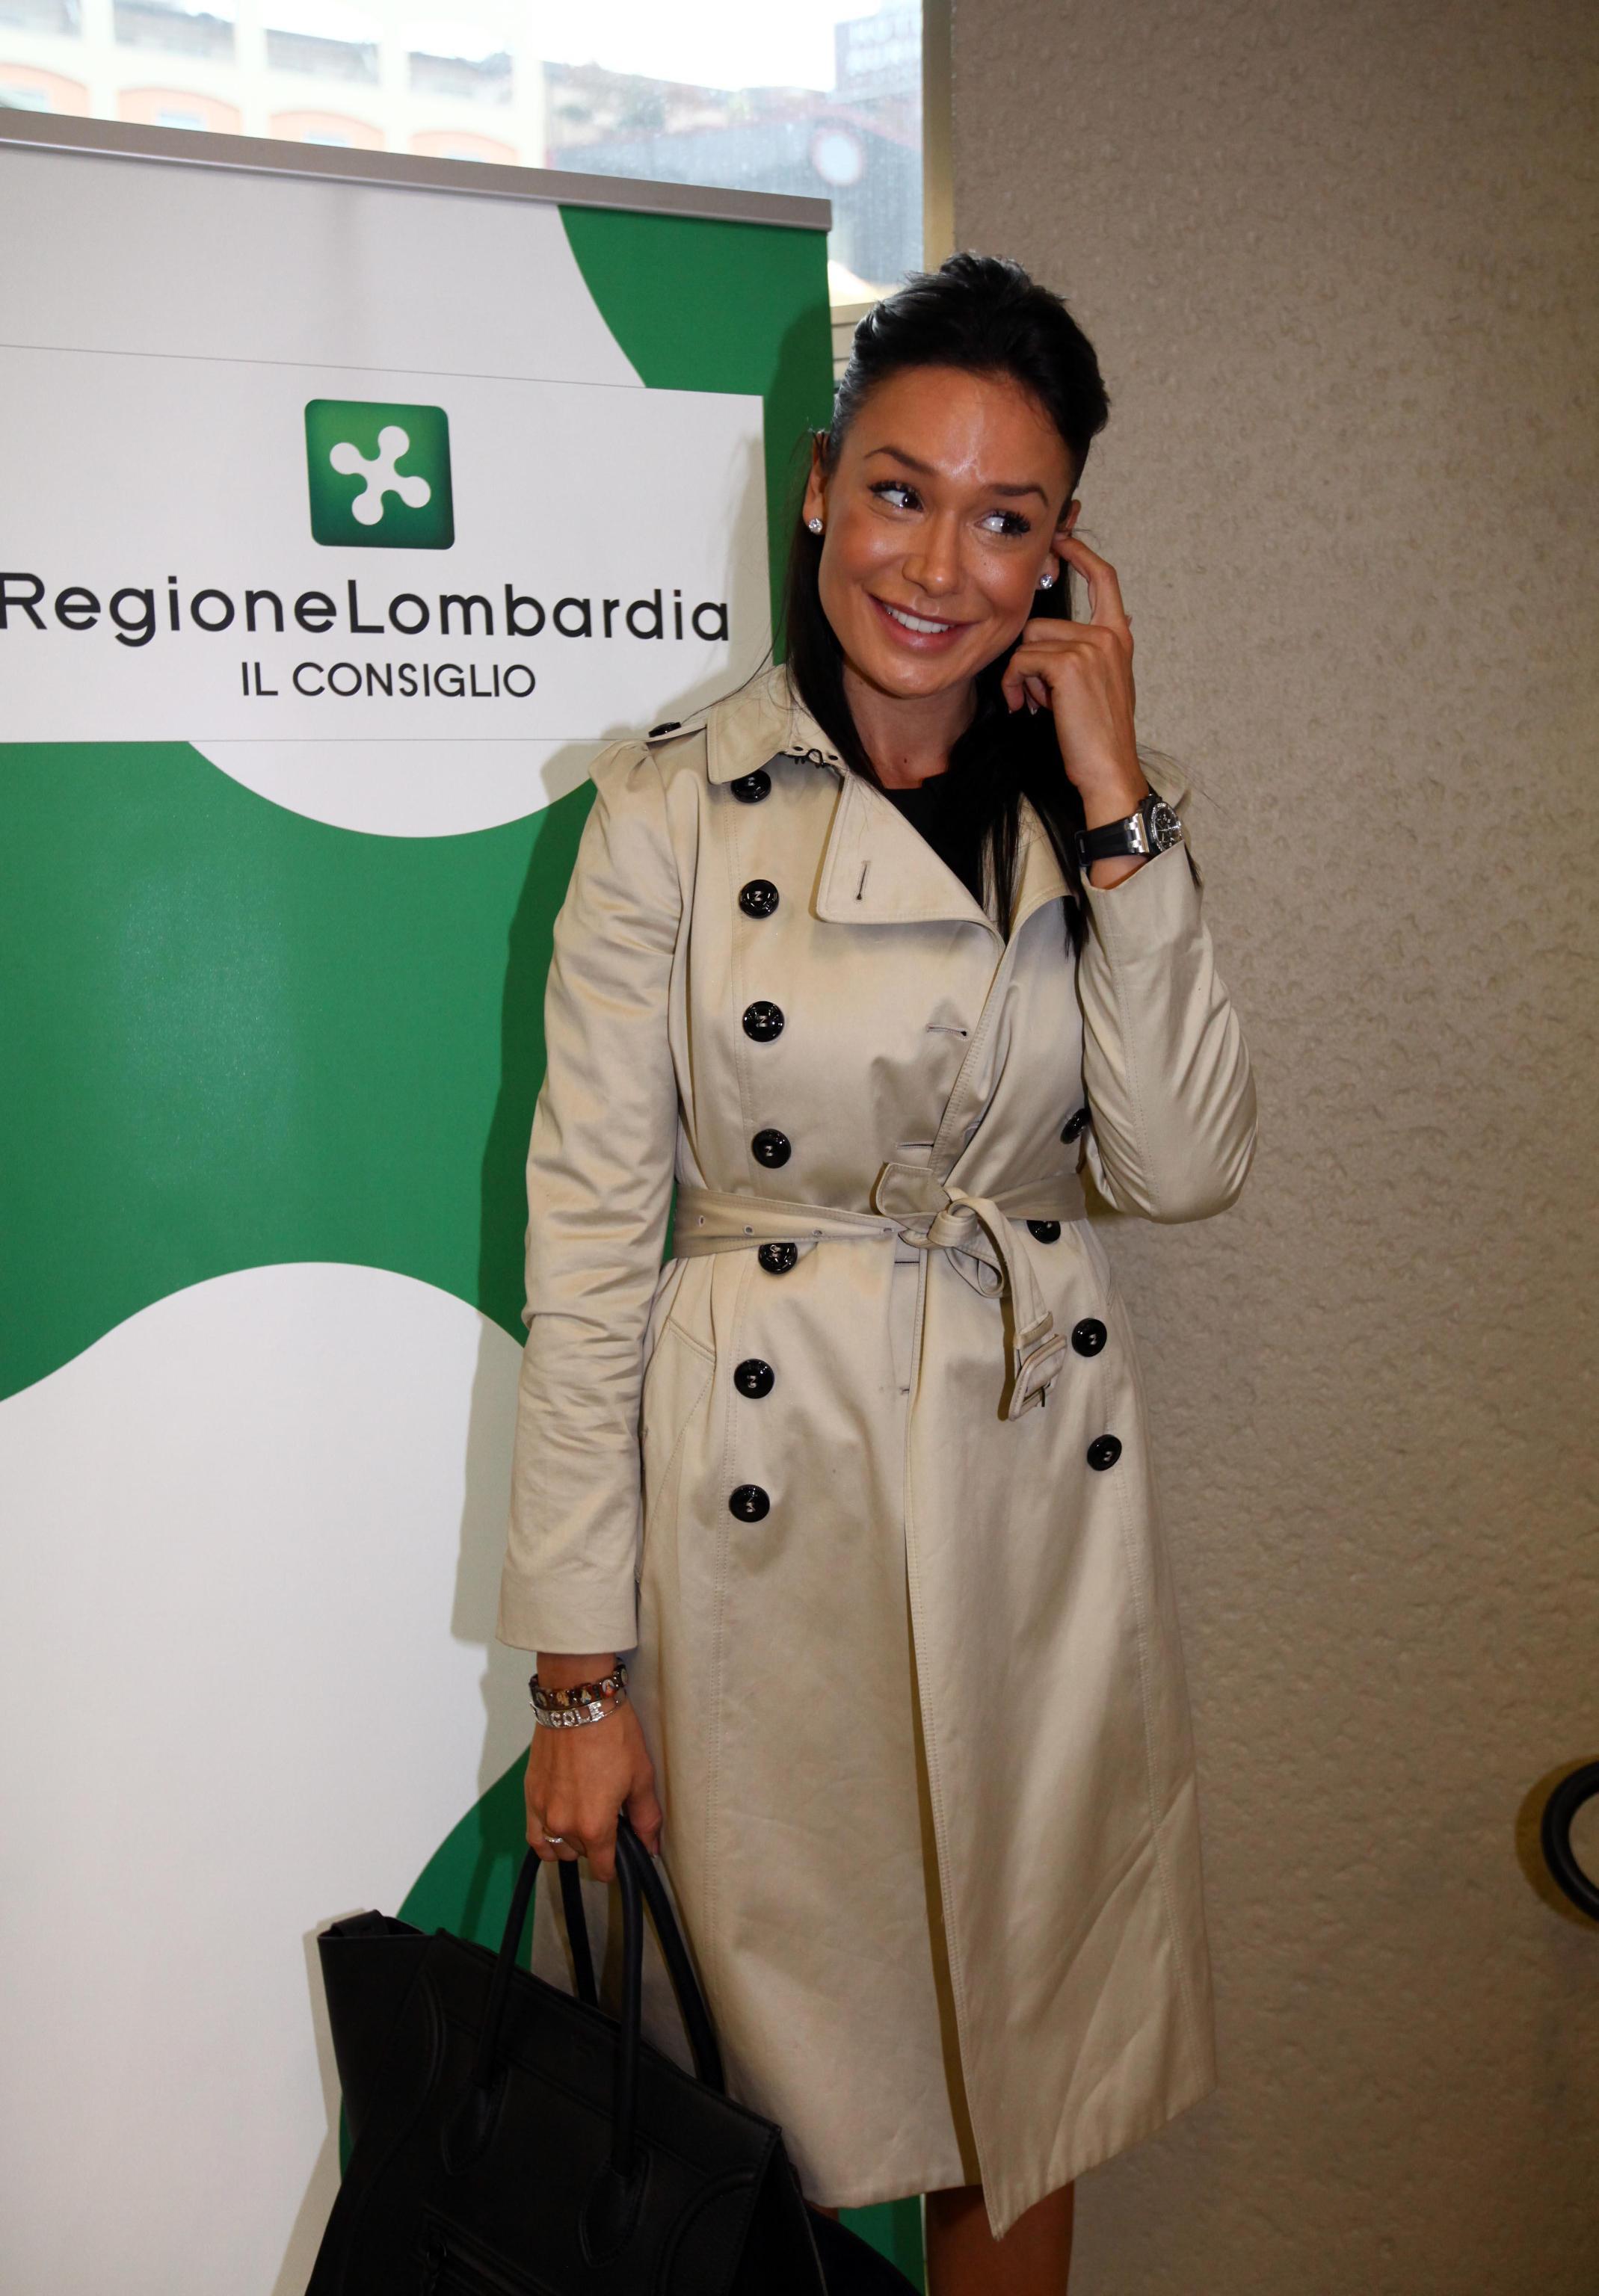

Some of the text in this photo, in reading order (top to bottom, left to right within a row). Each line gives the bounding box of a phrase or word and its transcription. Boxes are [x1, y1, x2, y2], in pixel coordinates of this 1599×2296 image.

[0, 572, 729, 647] RegioneLombardia
[241, 662, 536, 698] IL CONSIGLIO
